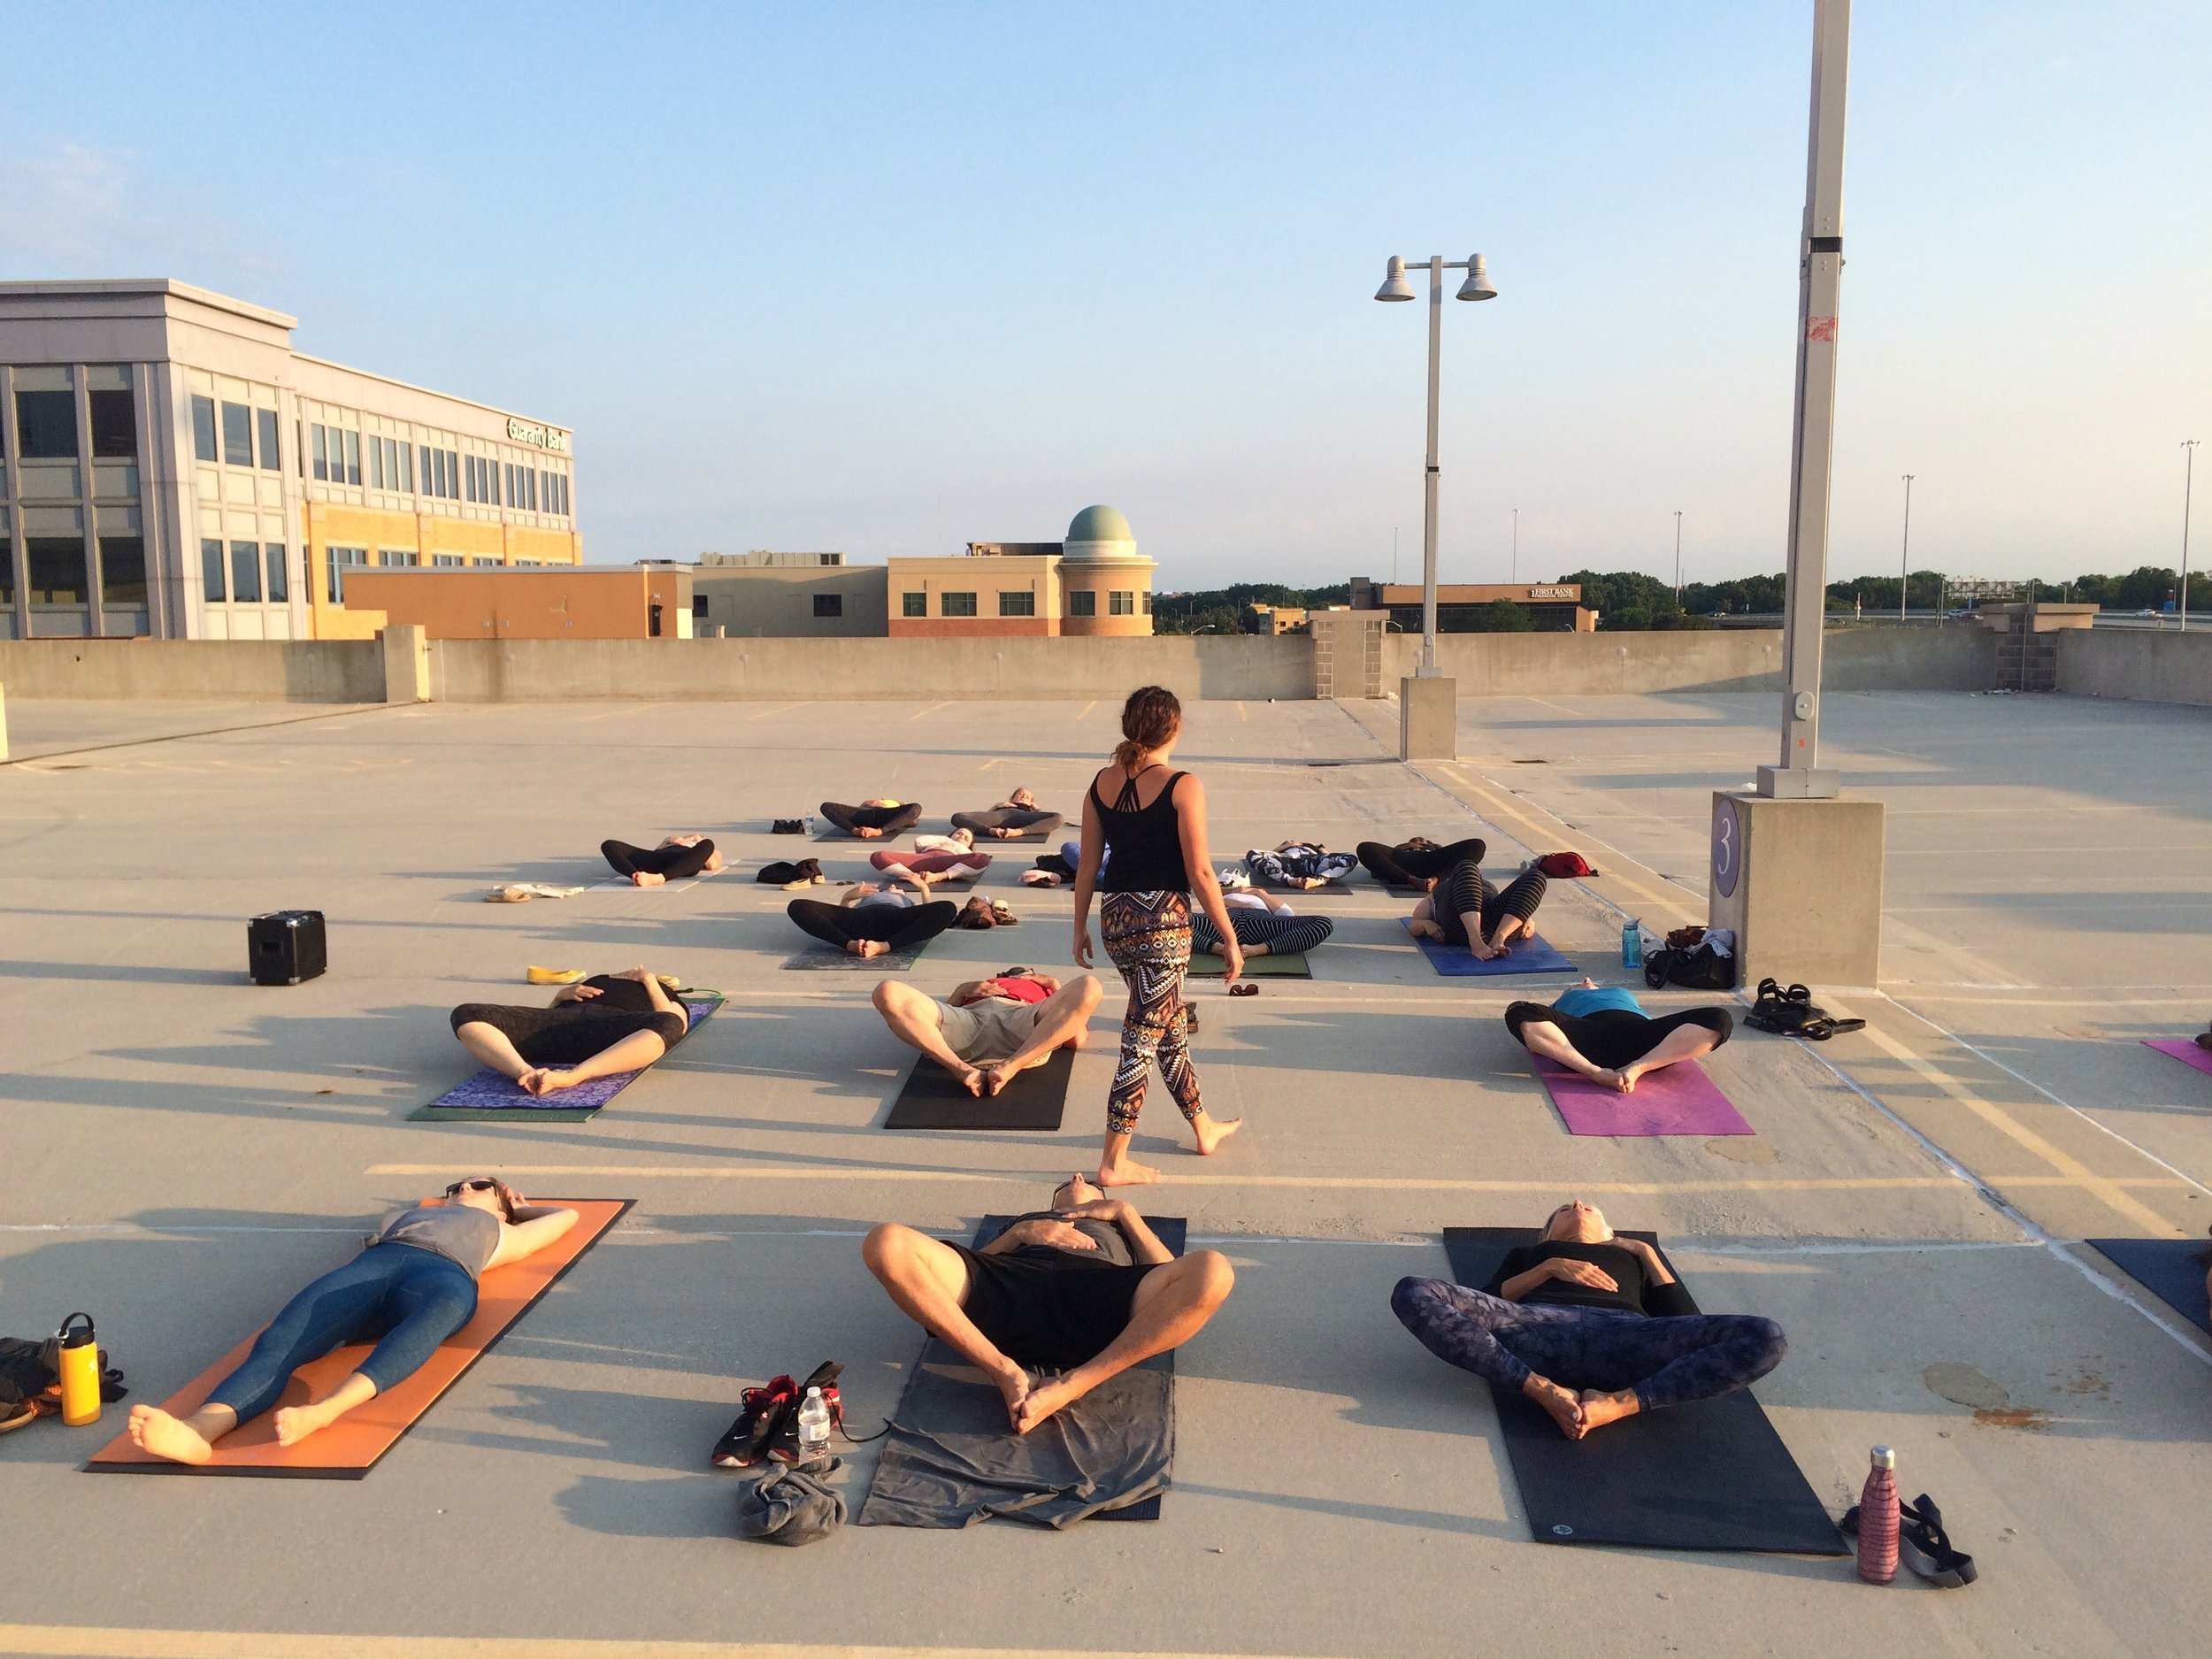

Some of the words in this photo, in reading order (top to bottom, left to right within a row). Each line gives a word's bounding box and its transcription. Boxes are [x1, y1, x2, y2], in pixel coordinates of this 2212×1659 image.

[508, 418, 547, 449] Guaranty
[547, 426, 565, 451] Bank
[1717, 818, 1732, 875] 3
